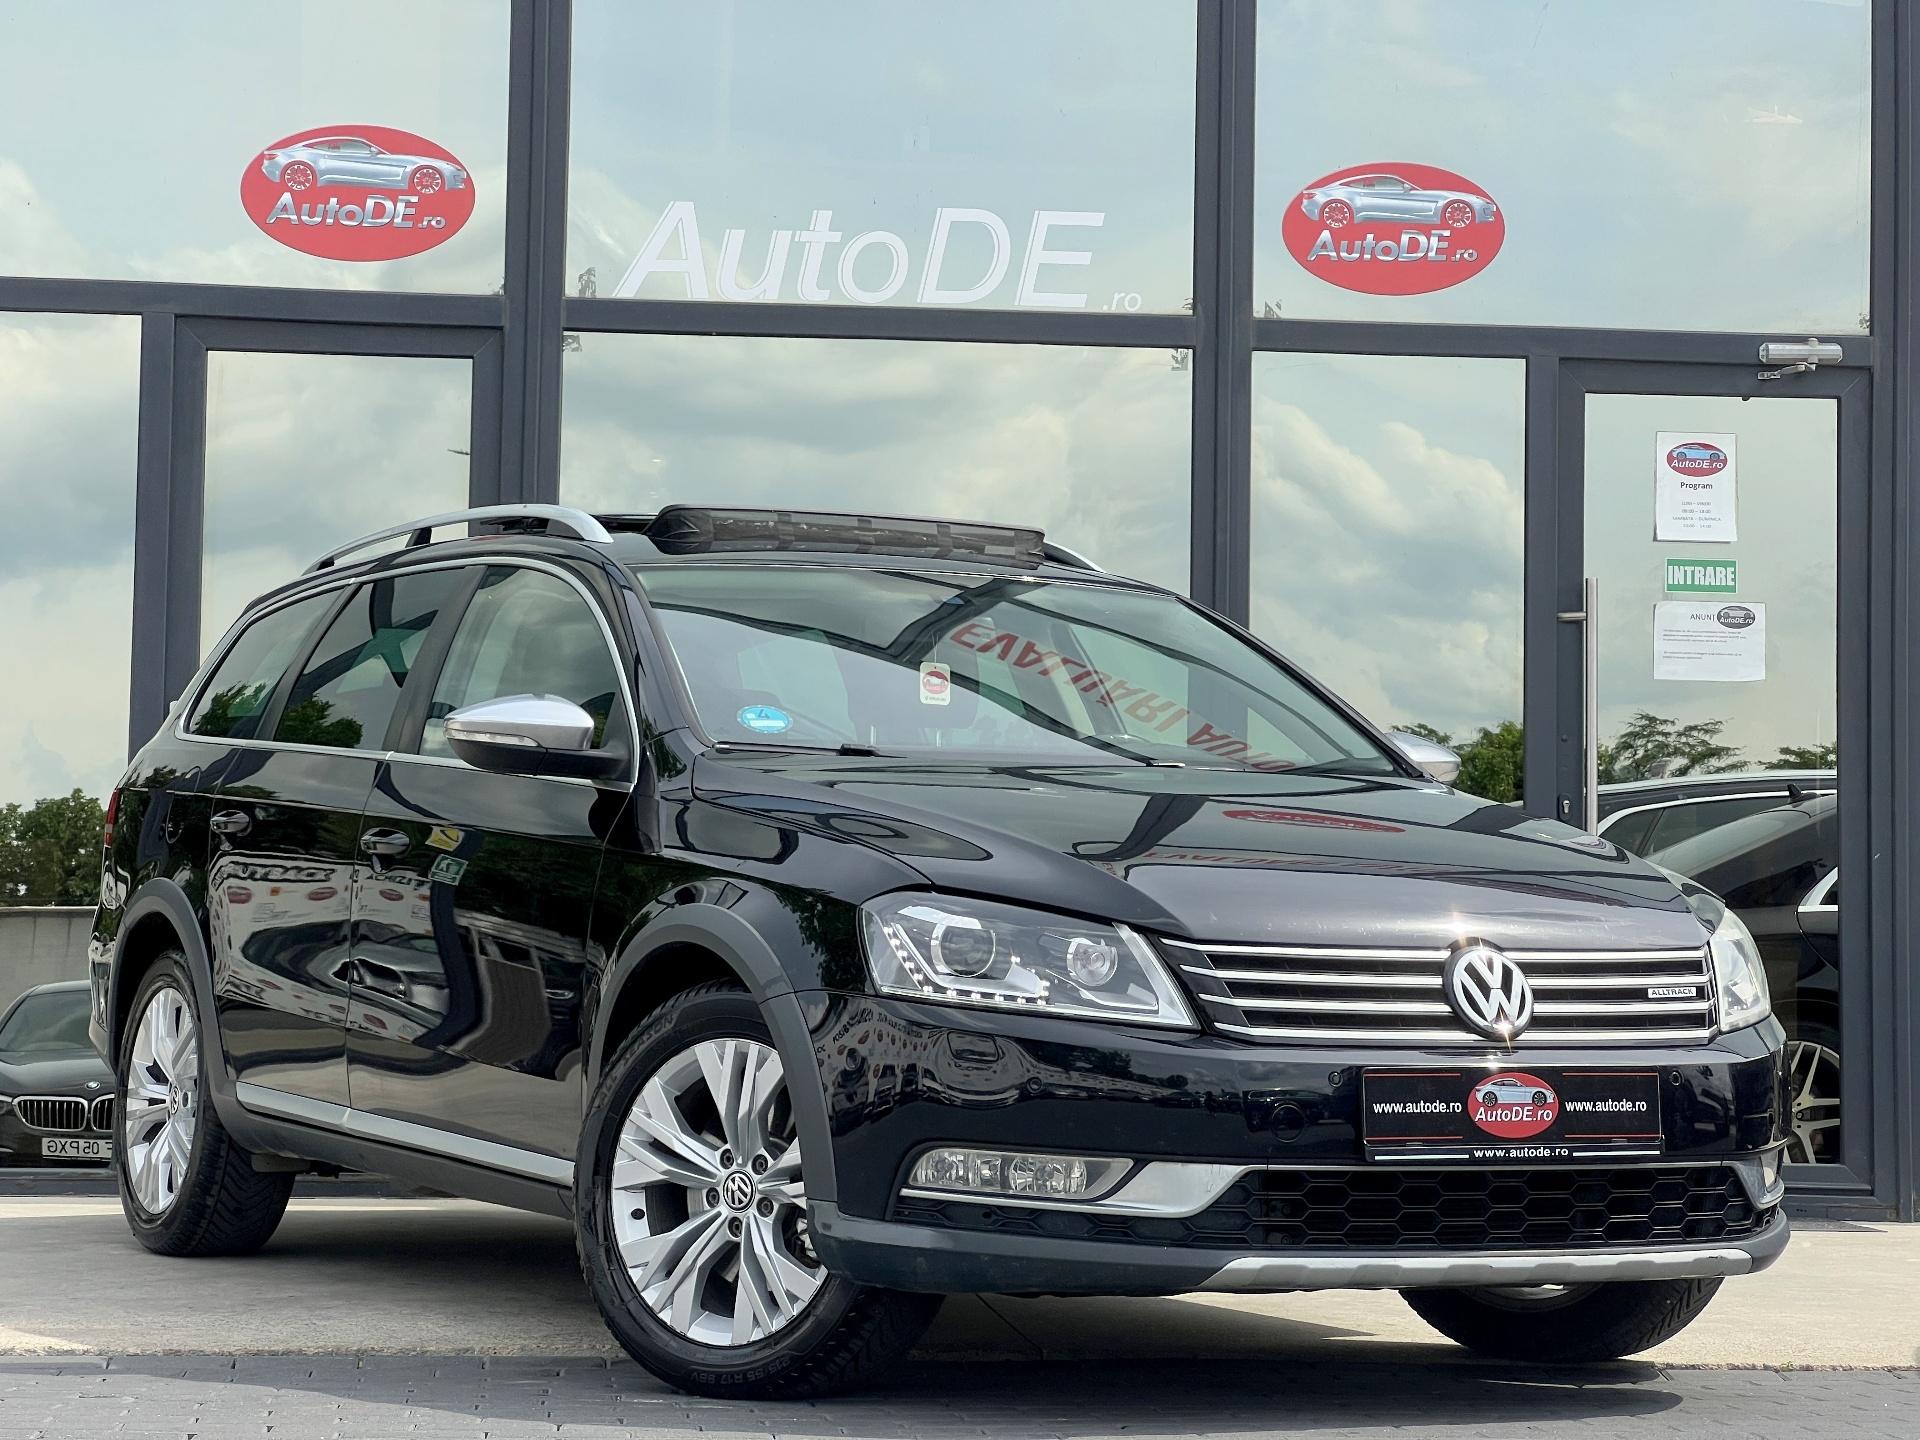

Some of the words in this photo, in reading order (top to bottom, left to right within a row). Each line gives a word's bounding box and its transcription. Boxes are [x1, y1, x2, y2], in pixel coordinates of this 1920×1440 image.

[1680, 481, 1713, 491] Program
[1667, 565, 1735, 586] INTRARE
[1651, 987, 1695, 997] ALLTRACK
[1372, 1099, 1462, 1114] www.autode.ro
[1565, 1098, 1647, 1112] www.autode.ro
[1474, 1106, 1553, 1122] AutoDE.ro
[1473, 1146, 1569, 1158] www.autode.ro
